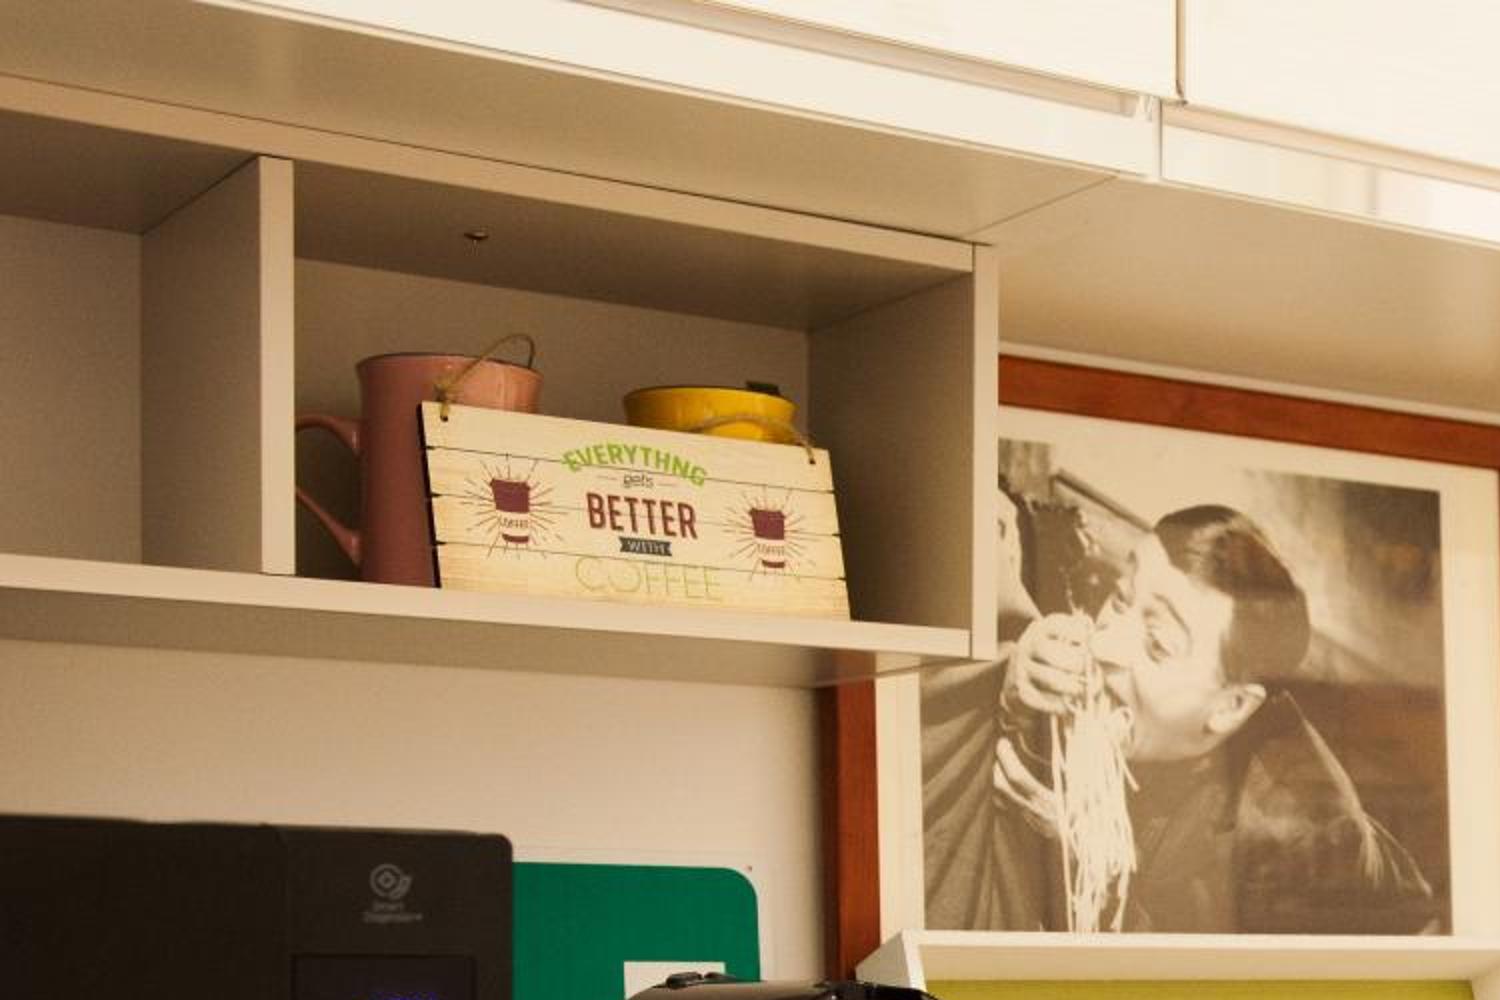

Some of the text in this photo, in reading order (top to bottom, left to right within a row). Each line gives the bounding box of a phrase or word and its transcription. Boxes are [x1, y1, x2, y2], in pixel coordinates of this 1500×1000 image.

[562, 443, 707, 487] EVERYTHNG
[586, 493, 698, 539] BETTER
[627, 540, 666, 554] WITH
[575, 556, 723, 600] COFFEE
